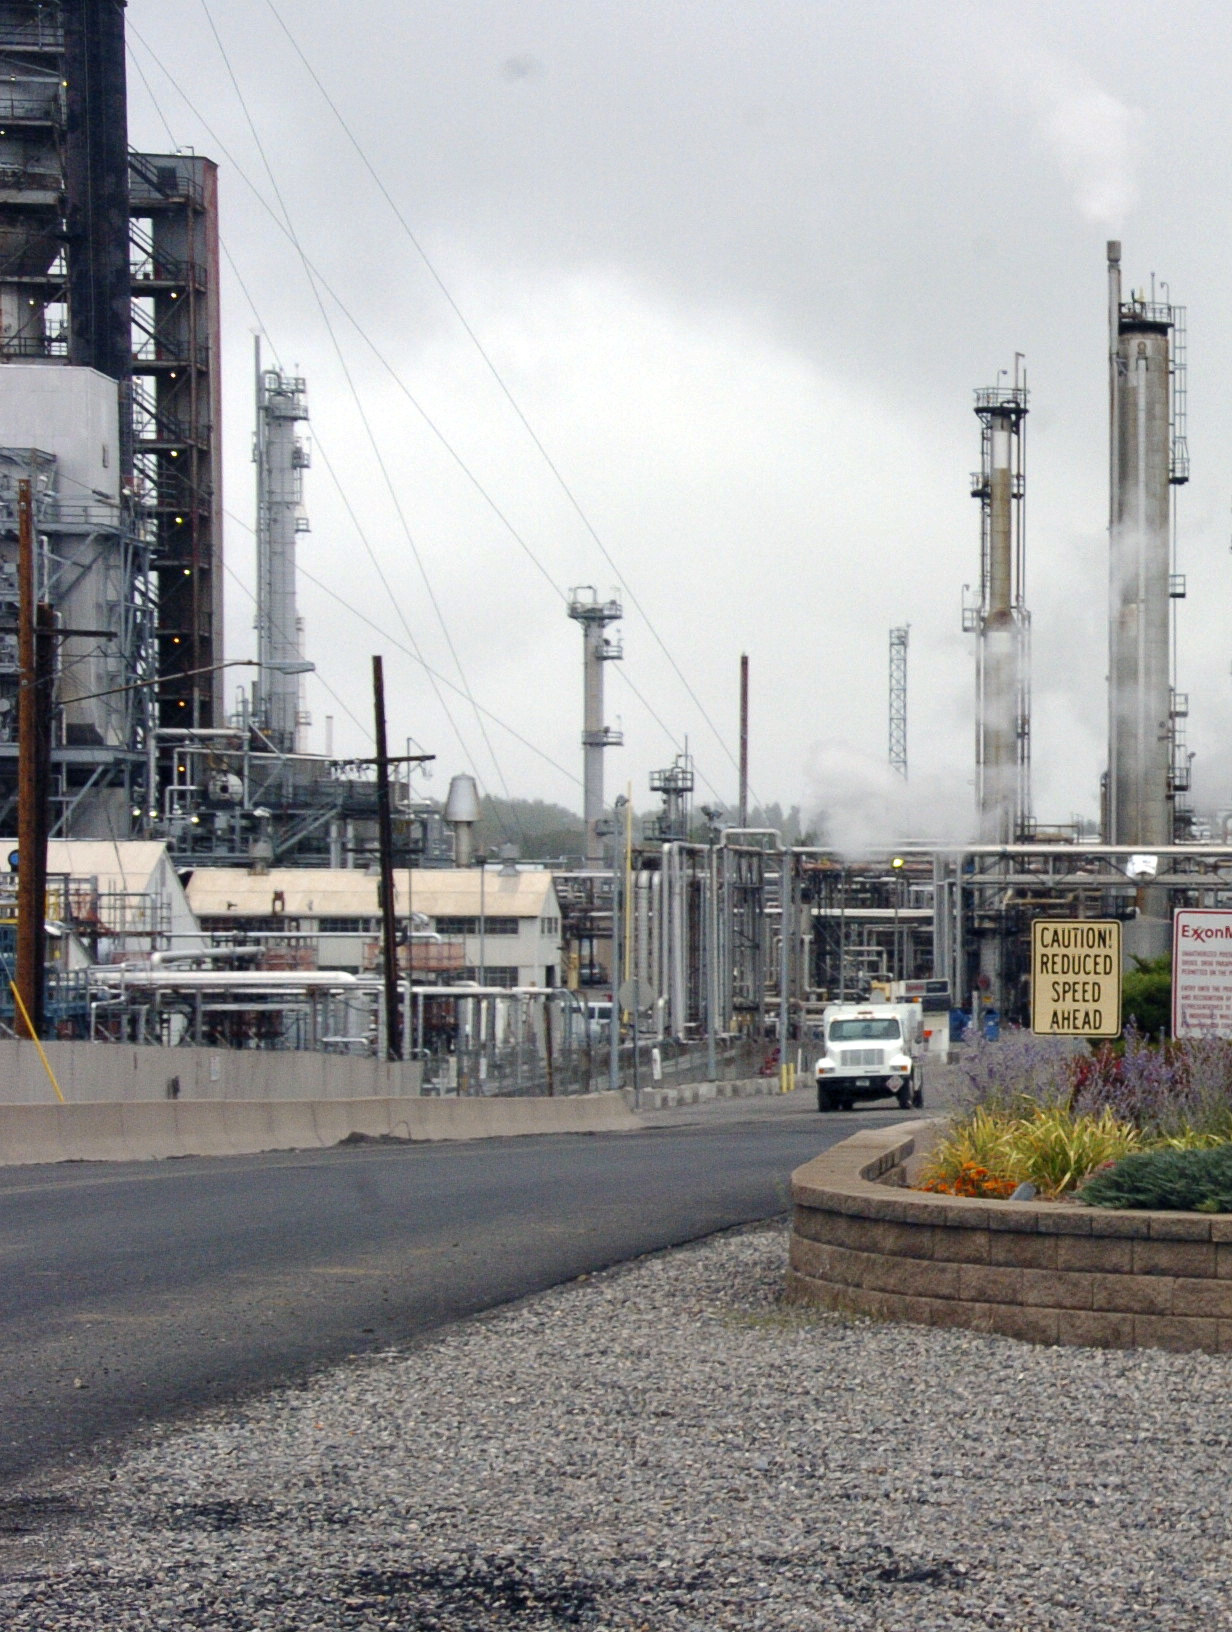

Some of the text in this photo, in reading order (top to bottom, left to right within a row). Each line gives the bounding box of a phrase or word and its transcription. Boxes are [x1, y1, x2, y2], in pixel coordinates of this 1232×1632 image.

[1040, 927, 1113, 949] CAUTION!
[1040, 954, 1113, 975] REDUCED
[1051, 981, 1101, 1003] SPEED
[1050, 1009, 1102, 1030] AHEAD
